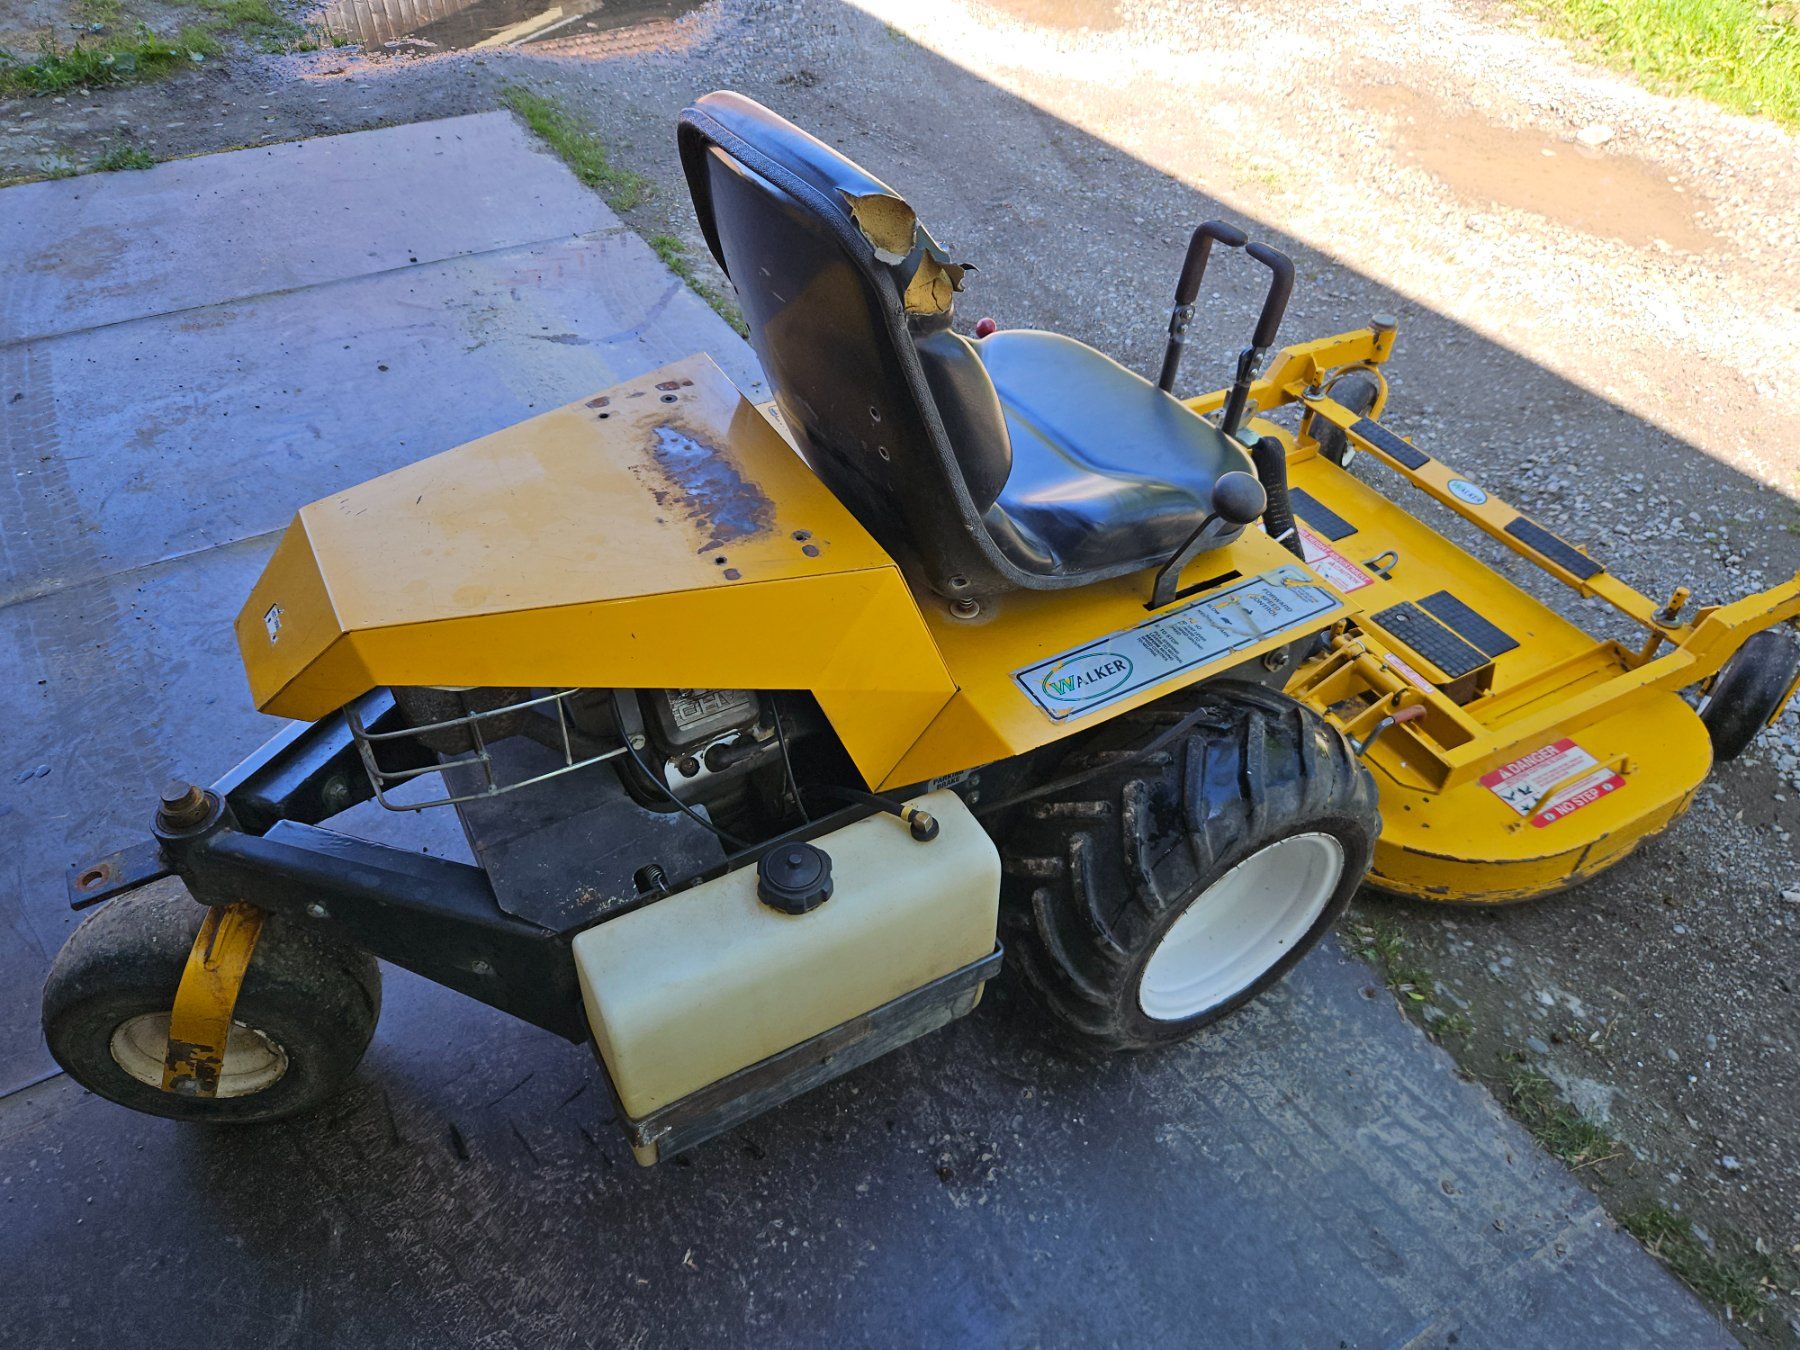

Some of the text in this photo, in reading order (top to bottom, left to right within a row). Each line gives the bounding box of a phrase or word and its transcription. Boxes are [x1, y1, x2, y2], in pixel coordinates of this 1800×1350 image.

[1262, 588, 1293, 612] FORWARD
[1050, 659, 1127, 695] WALKER
[1508, 745, 1560, 775] DANGER
[1554, 788, 1599, 816] NO STEP
